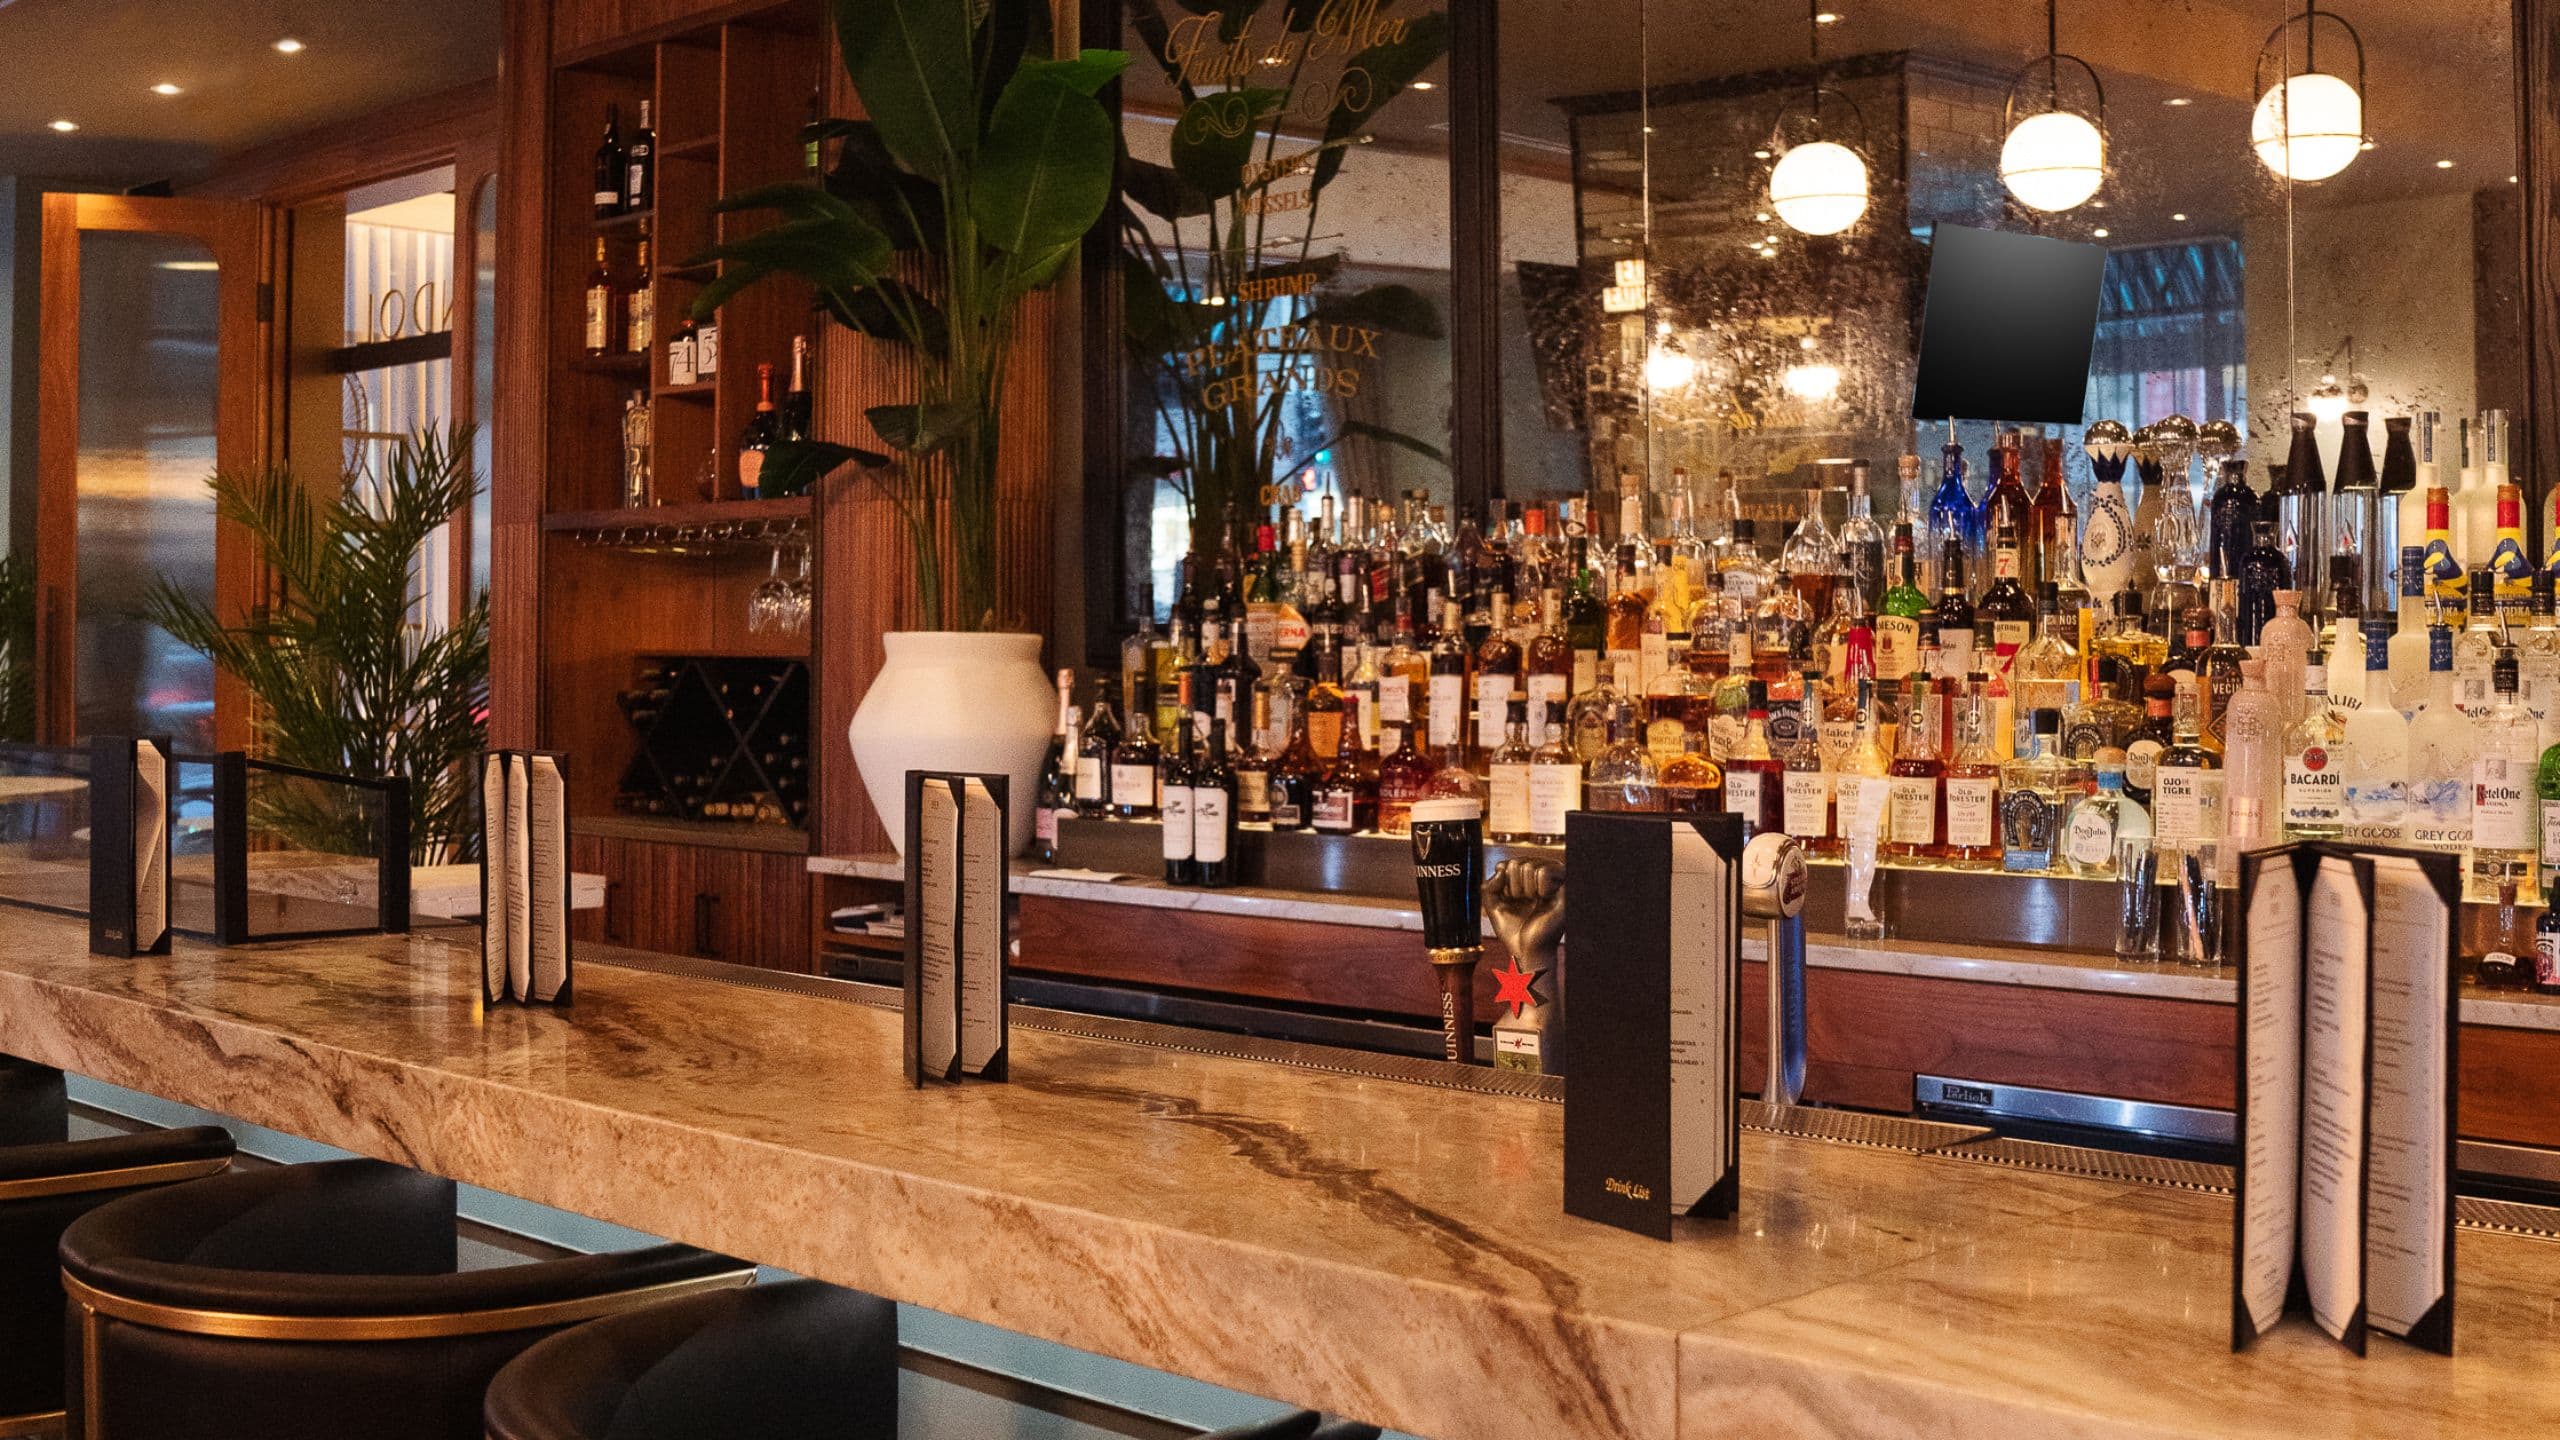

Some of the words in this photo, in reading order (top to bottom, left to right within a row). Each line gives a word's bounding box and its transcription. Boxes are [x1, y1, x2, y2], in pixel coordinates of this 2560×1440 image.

[1238, 272, 1318, 302] SHRIMP
[1186, 322, 1384, 377] PLATEAUX
[1202, 365, 1361, 411] GRANDS
[1998, 557, 2010, 576] 7
[1995, 642, 2021, 673] 7
[2163, 778, 2181, 786] OJO
[2290, 770, 2340, 785] BACARDÍ
[1786, 787, 1822, 796] FORESTER
[1893, 791, 1930, 801] FORESTER
[1949, 793, 1986, 803] FORESTER
[2163, 786, 2191, 796] TIGRE
[2501, 787, 2520, 800] One
[2361, 827, 2401, 839] GOOSE
[2415, 829, 2444, 841] GREY
[1441, 991, 1459, 1062] UINNESS
[1945, 1084, 1989, 1103] Perlick
[1604, 1177, 1633, 1200] Drink
[1632, 1183, 1650, 1200] List
